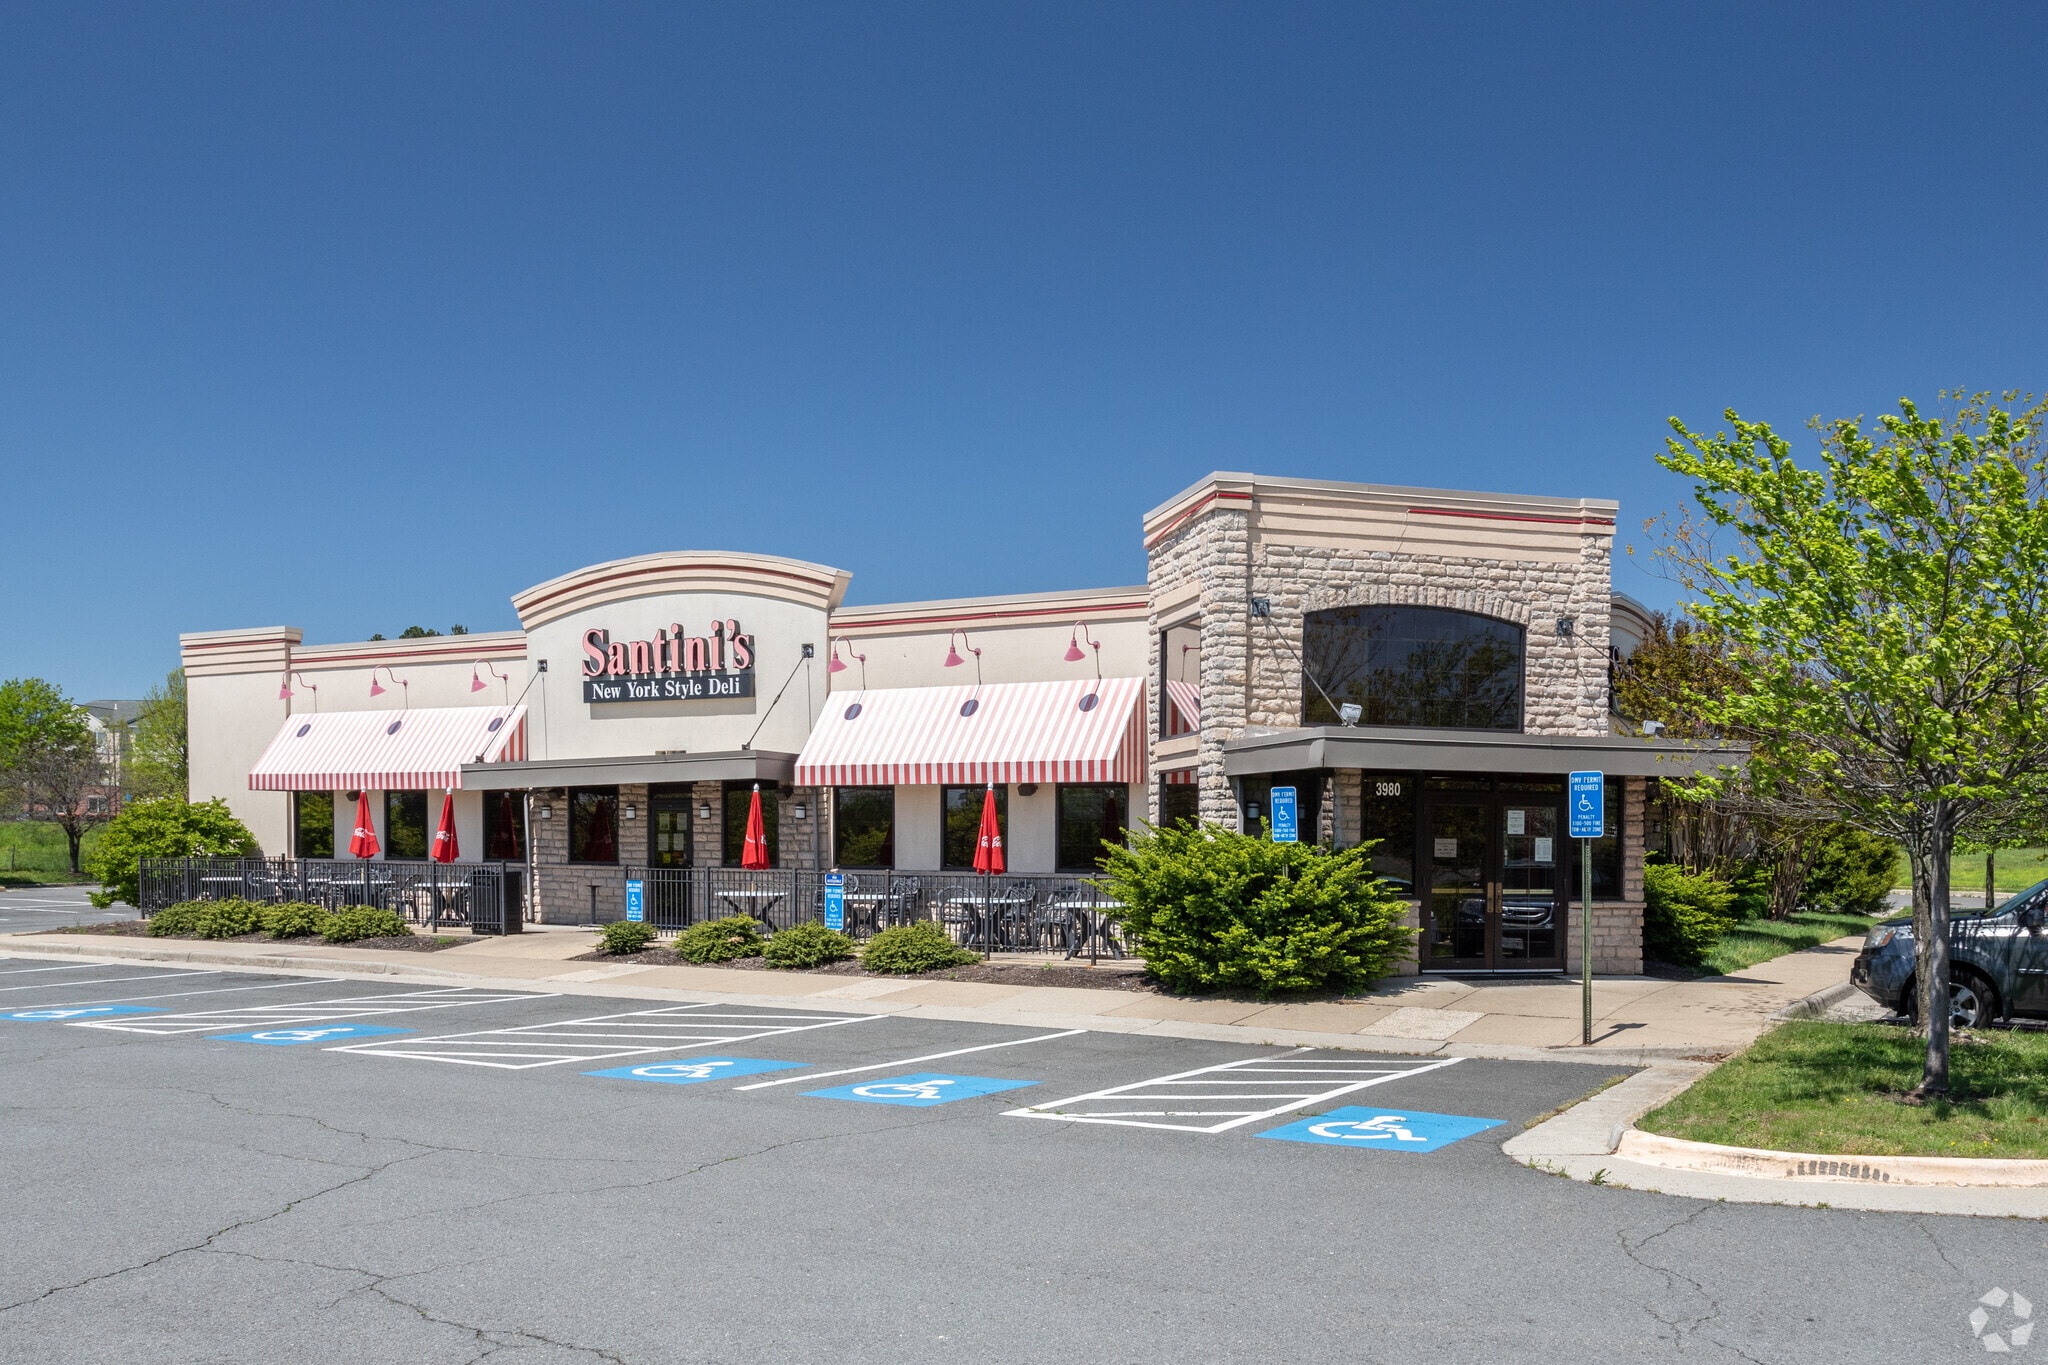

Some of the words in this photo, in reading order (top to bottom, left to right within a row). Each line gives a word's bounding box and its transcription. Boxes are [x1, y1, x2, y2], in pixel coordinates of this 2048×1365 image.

[582, 618, 754, 676] Santini's
[592, 683, 621, 699] New
[627, 681, 660, 698] York
[665, 679, 702, 699] Style
[708, 677, 741, 695] Deli
[1375, 782, 1401, 796] 3980
